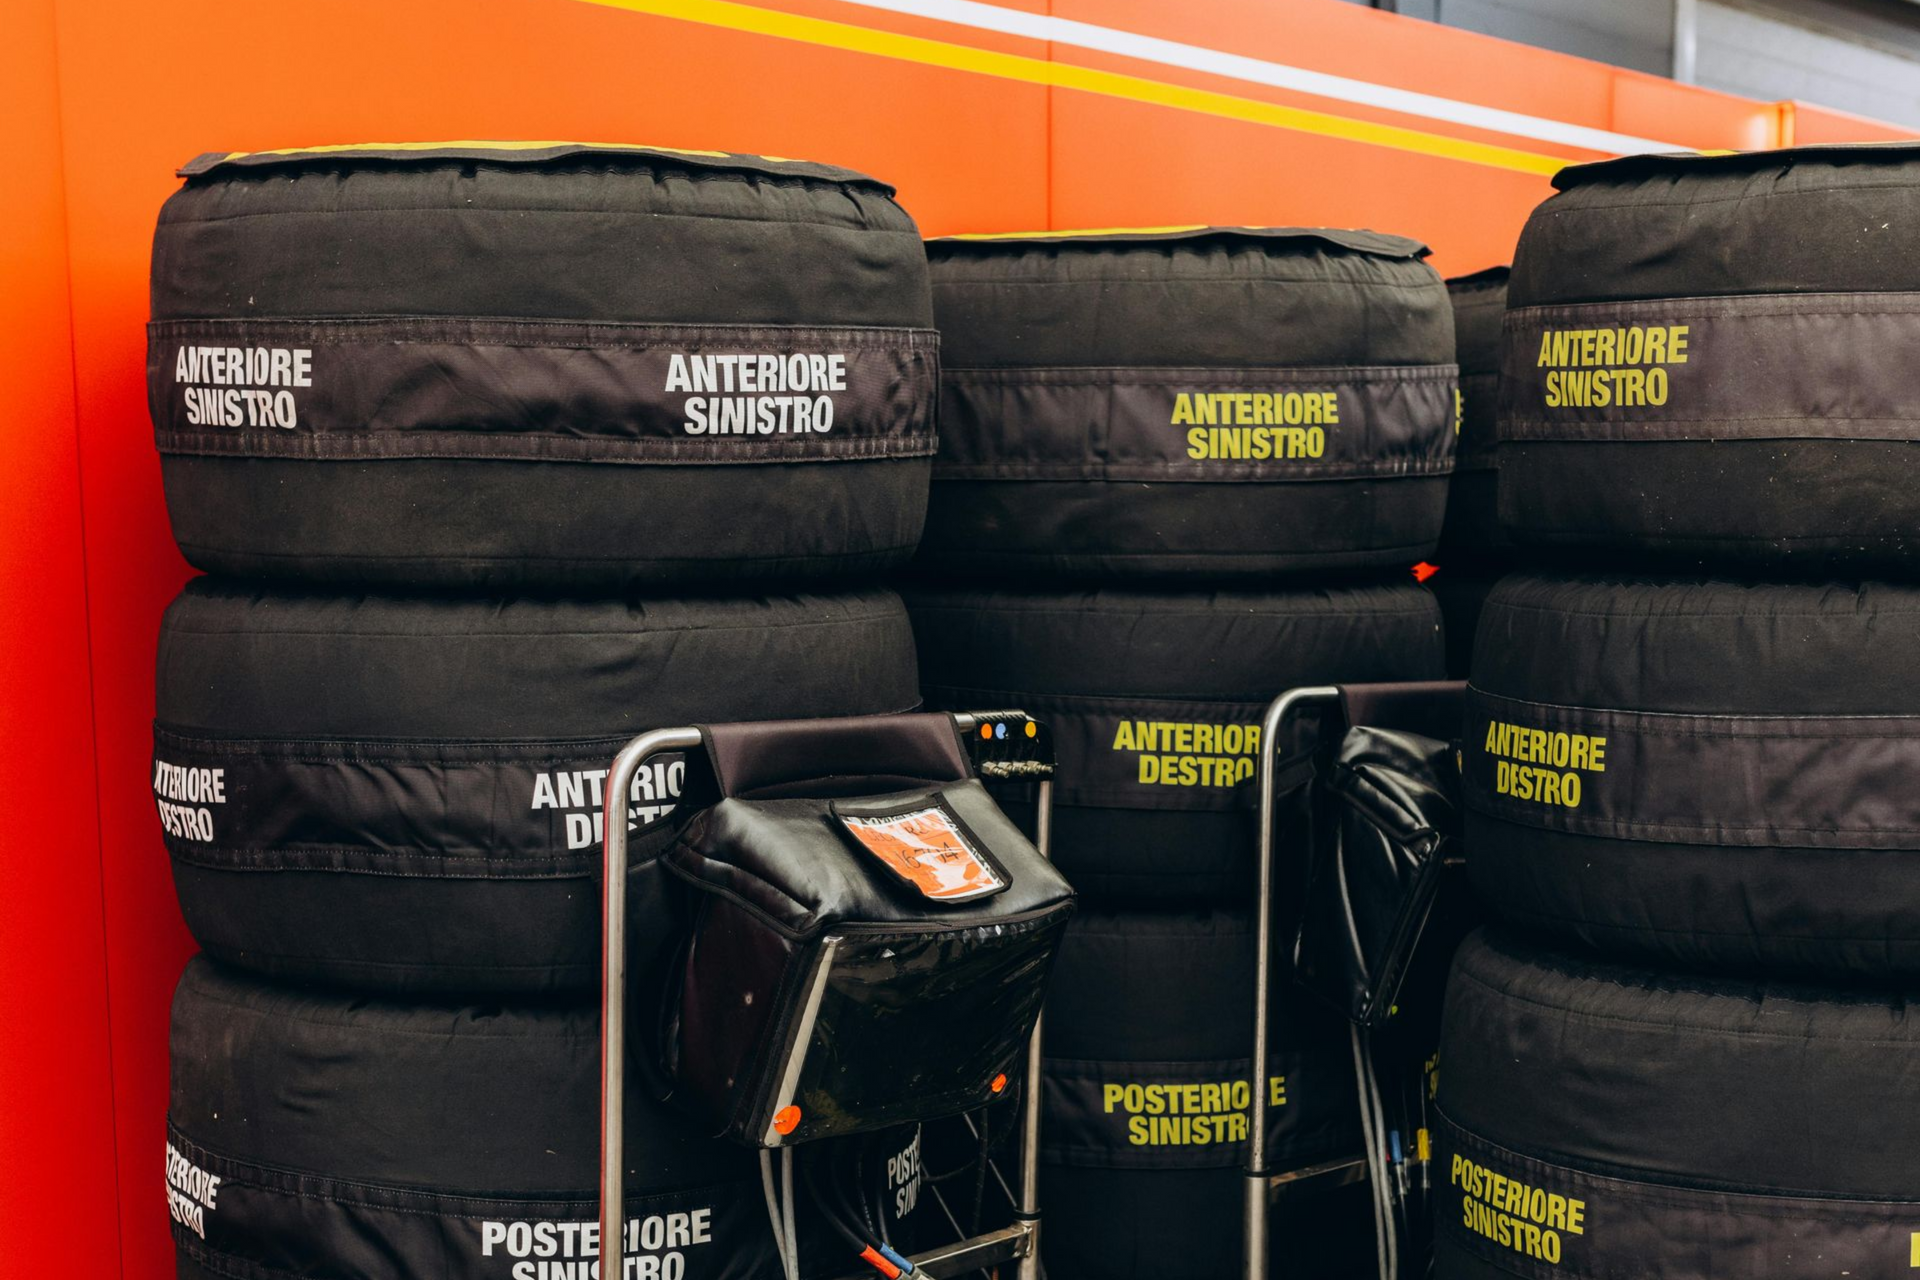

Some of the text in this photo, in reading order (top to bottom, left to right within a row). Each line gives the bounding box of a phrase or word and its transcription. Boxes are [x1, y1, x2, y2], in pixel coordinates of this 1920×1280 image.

[176, 346, 312, 387] ANTERIORE
[1537, 326, 1689, 367] ANTERIORE
[665, 353, 846, 392] ANTERIORE
[1545, 367, 1668, 407] SINISTRO
[184, 387, 297, 429] SINISTRO
[684, 395, 834, 435] SINISTRO
[1170, 392, 1339, 425] ANTERIORE
[1187, 426, 1325, 460] SINISTRO
[1112, 720, 1281, 755] ANTERIOR
[1485, 720, 1607, 772] ANTERIORE
[1138, 754, 1254, 787] DESTRO
[1497, 760, 1581, 808] DESTRO
[1103, 1076, 1287, 1115] POSTERIOE
[1128, 1112, 1250, 1145] SINISTR
[1451, 1153, 1586, 1236] POSTERIORE
[482, 1207, 712, 1258] POSTEIORE
[1463, 1195, 1562, 1265] SINISTRO
[512, 1251, 686, 1280] SINITRO
